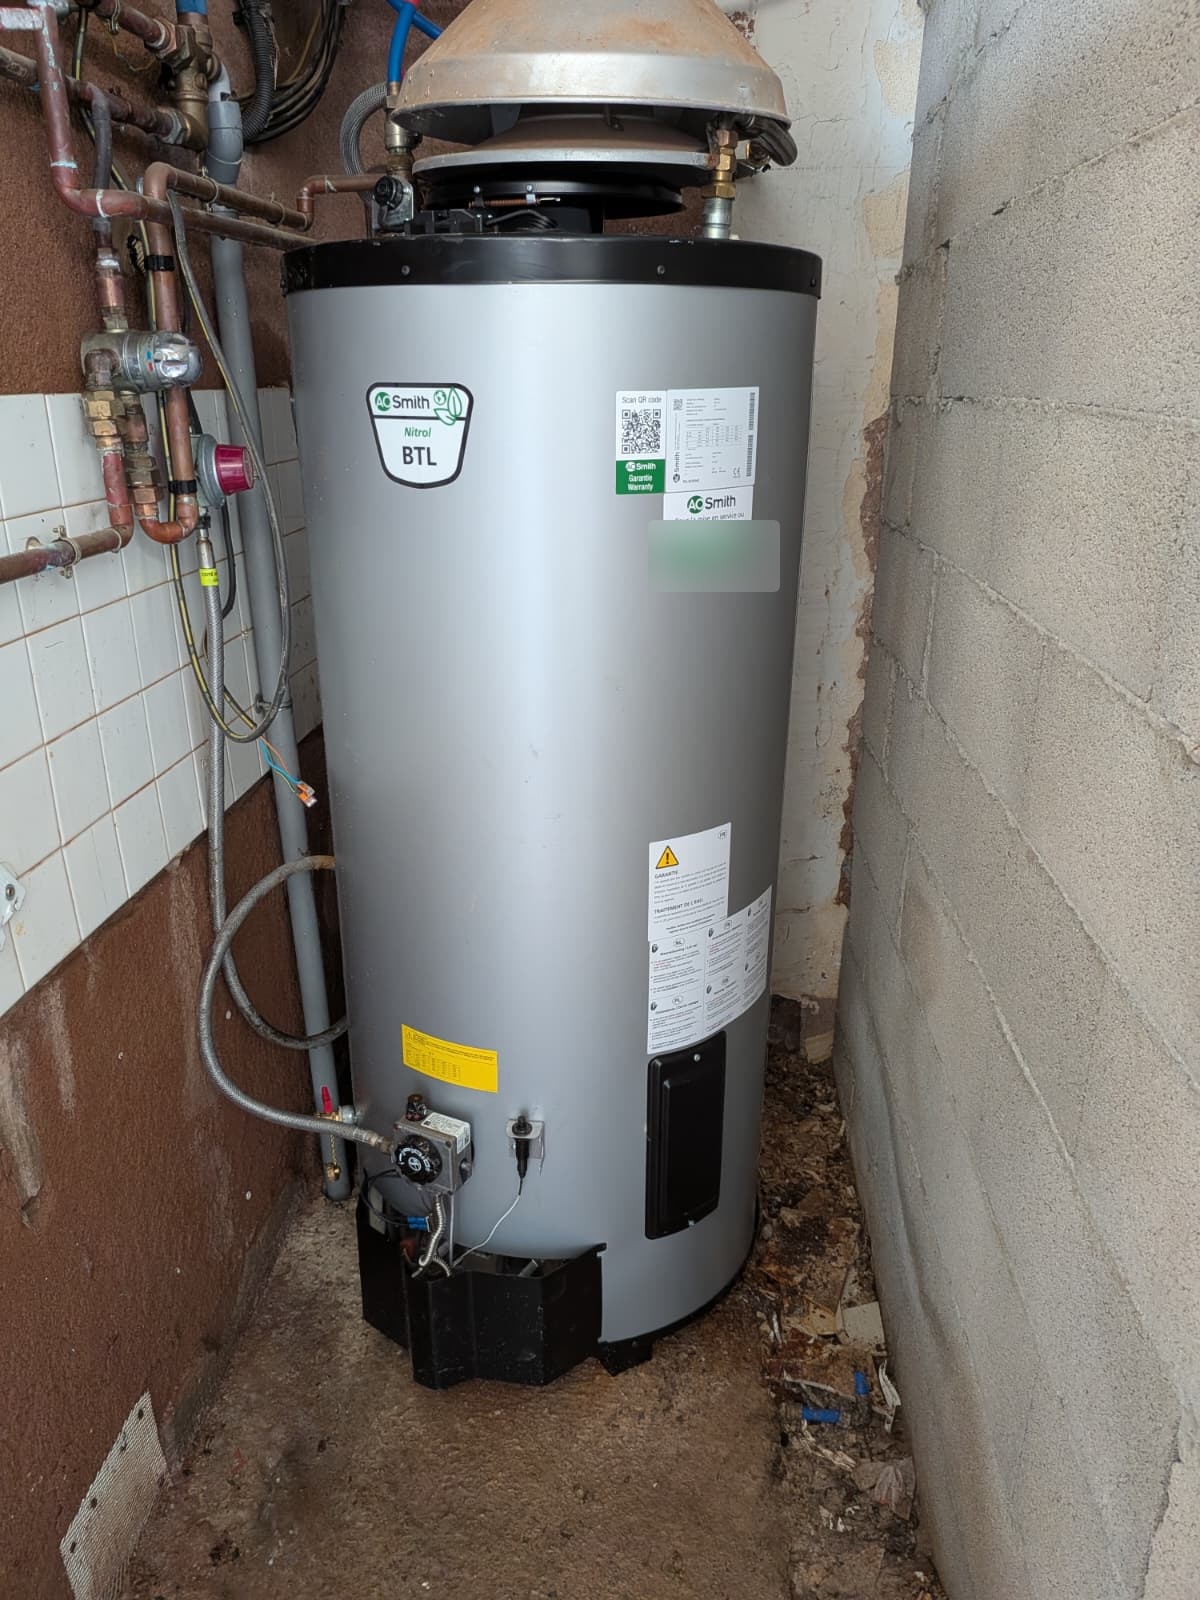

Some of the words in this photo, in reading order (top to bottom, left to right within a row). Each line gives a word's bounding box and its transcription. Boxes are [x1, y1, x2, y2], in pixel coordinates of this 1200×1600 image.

[392, 395, 430, 409] Smith
[621, 396, 637, 404] Scan
[637, 396, 647, 404] QR
[402, 446, 437, 466] BTL
[636, 463, 656, 471] Smith
[628, 474, 653, 482] Garantie
[627, 483, 654, 491] Warranty
[704, 495, 736, 509] Smith
